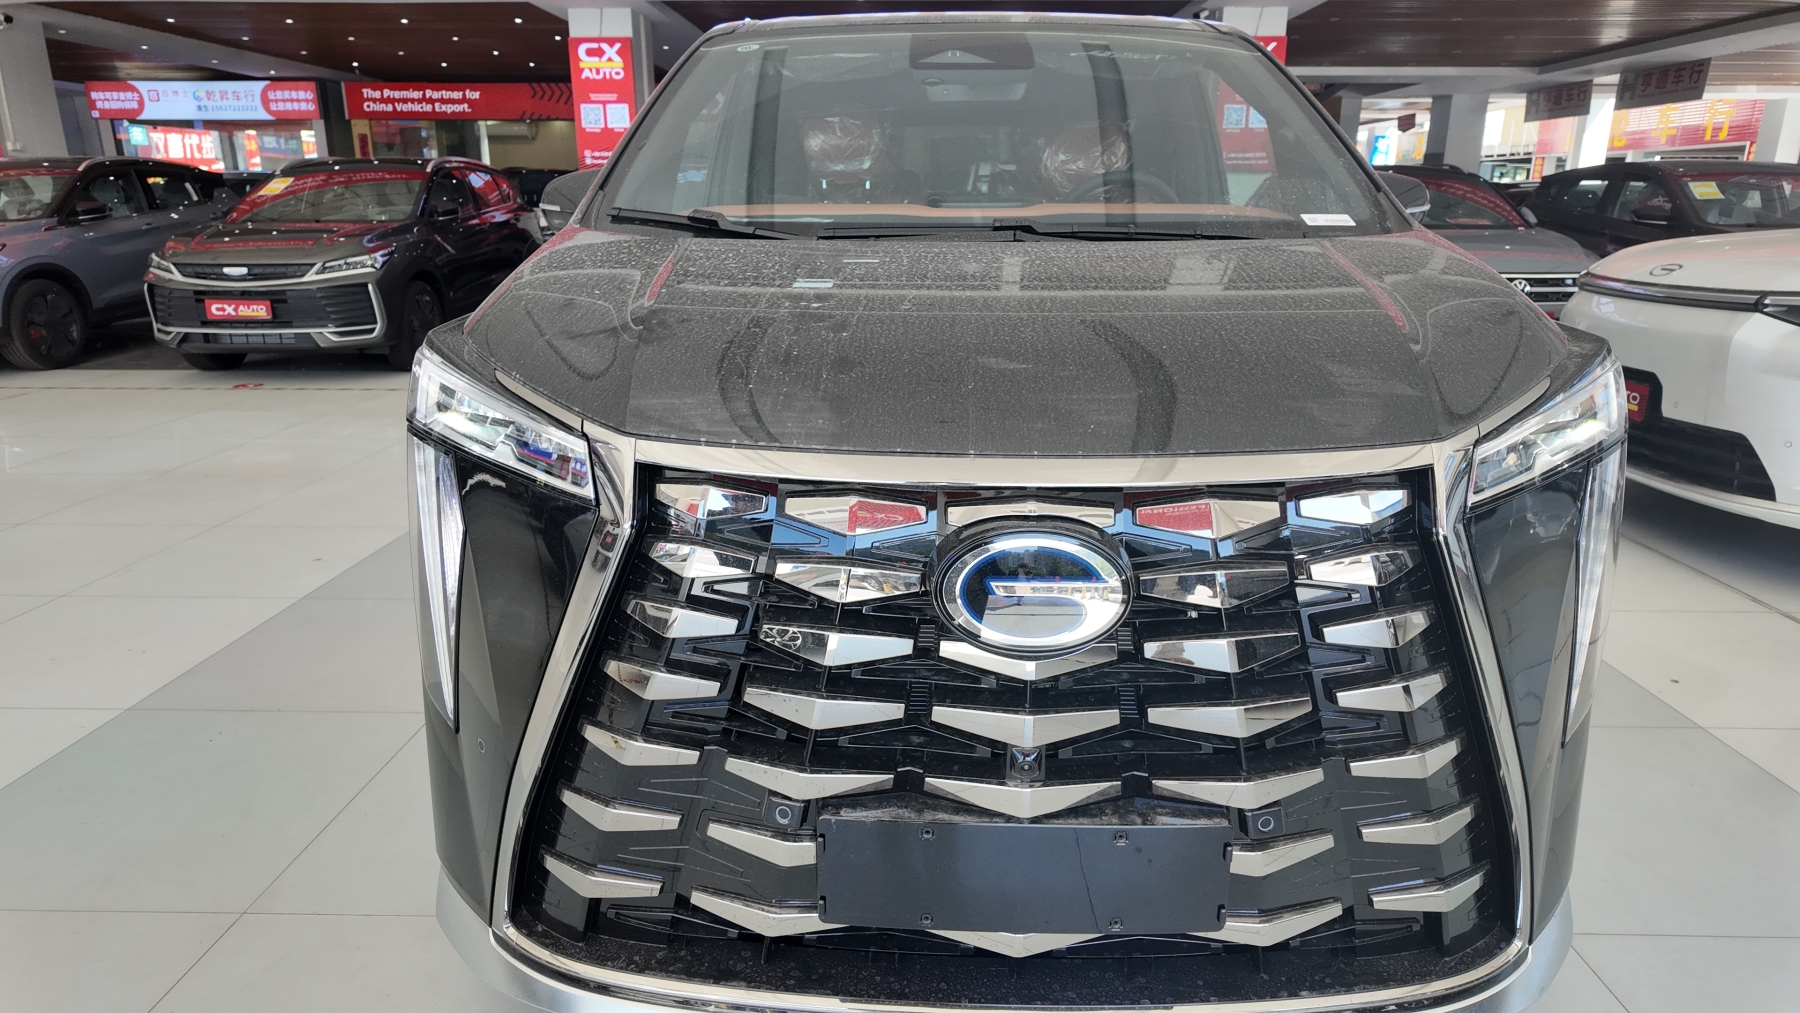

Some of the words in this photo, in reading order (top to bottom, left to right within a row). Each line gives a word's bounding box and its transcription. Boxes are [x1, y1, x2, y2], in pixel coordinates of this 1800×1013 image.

[578, 42, 623, 62] CX
[581, 67, 625, 80] AUTO
[361, 88, 381, 99] The
[383, 88, 423, 99] Premier
[425, 89, 464, 99] Partner
[465, 89, 481, 99] for
[363, 101, 393, 112] China
[394, 101, 433, 112] Vehicle
[434, 102, 472, 114] Export.
[210, 303, 237, 316] CX
[237, 304, 267, 313] AUTO
